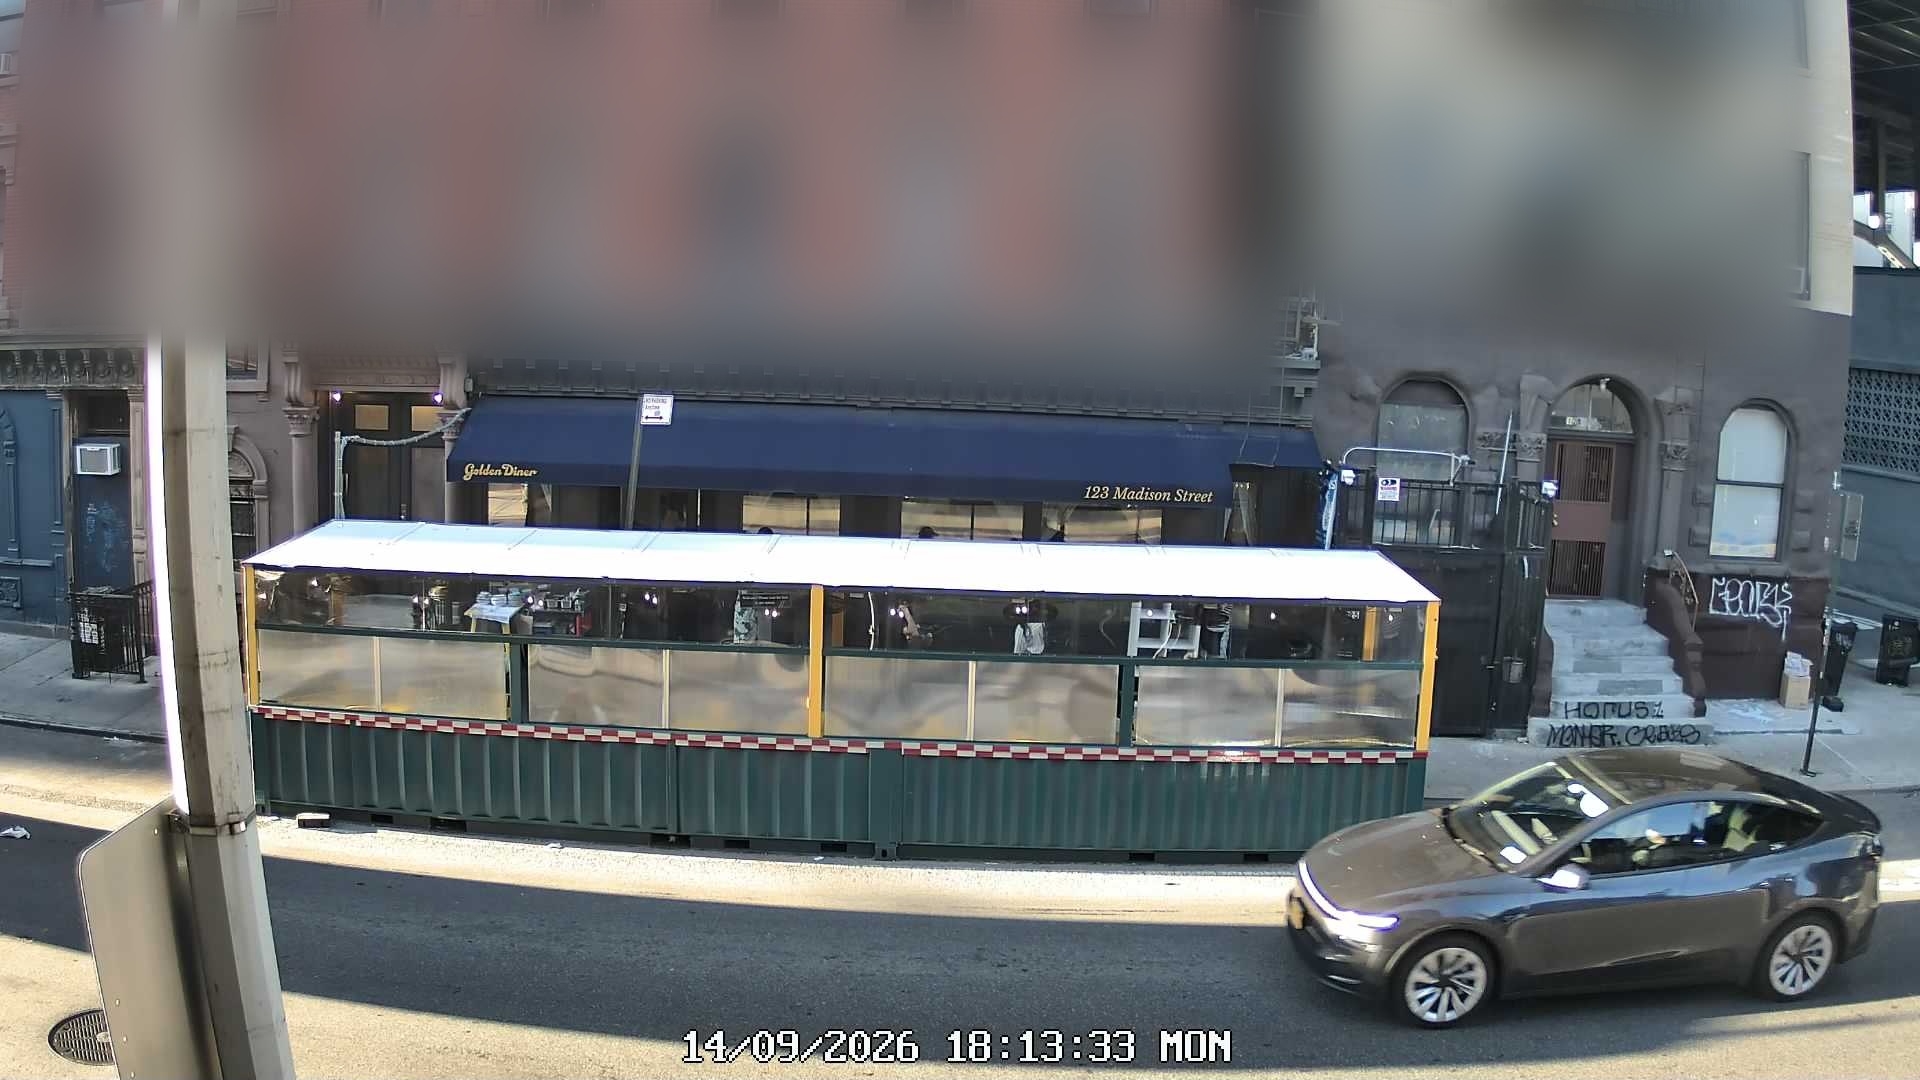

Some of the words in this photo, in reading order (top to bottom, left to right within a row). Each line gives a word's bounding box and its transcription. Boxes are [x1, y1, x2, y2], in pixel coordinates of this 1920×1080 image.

[462, 463, 502, 480] Golden
[502, 463, 538, 477] Diner
[1084, 485, 1109, 499] 123
[1113, 486, 1171, 501] Madison
[1174, 489, 1214, 503] Street
